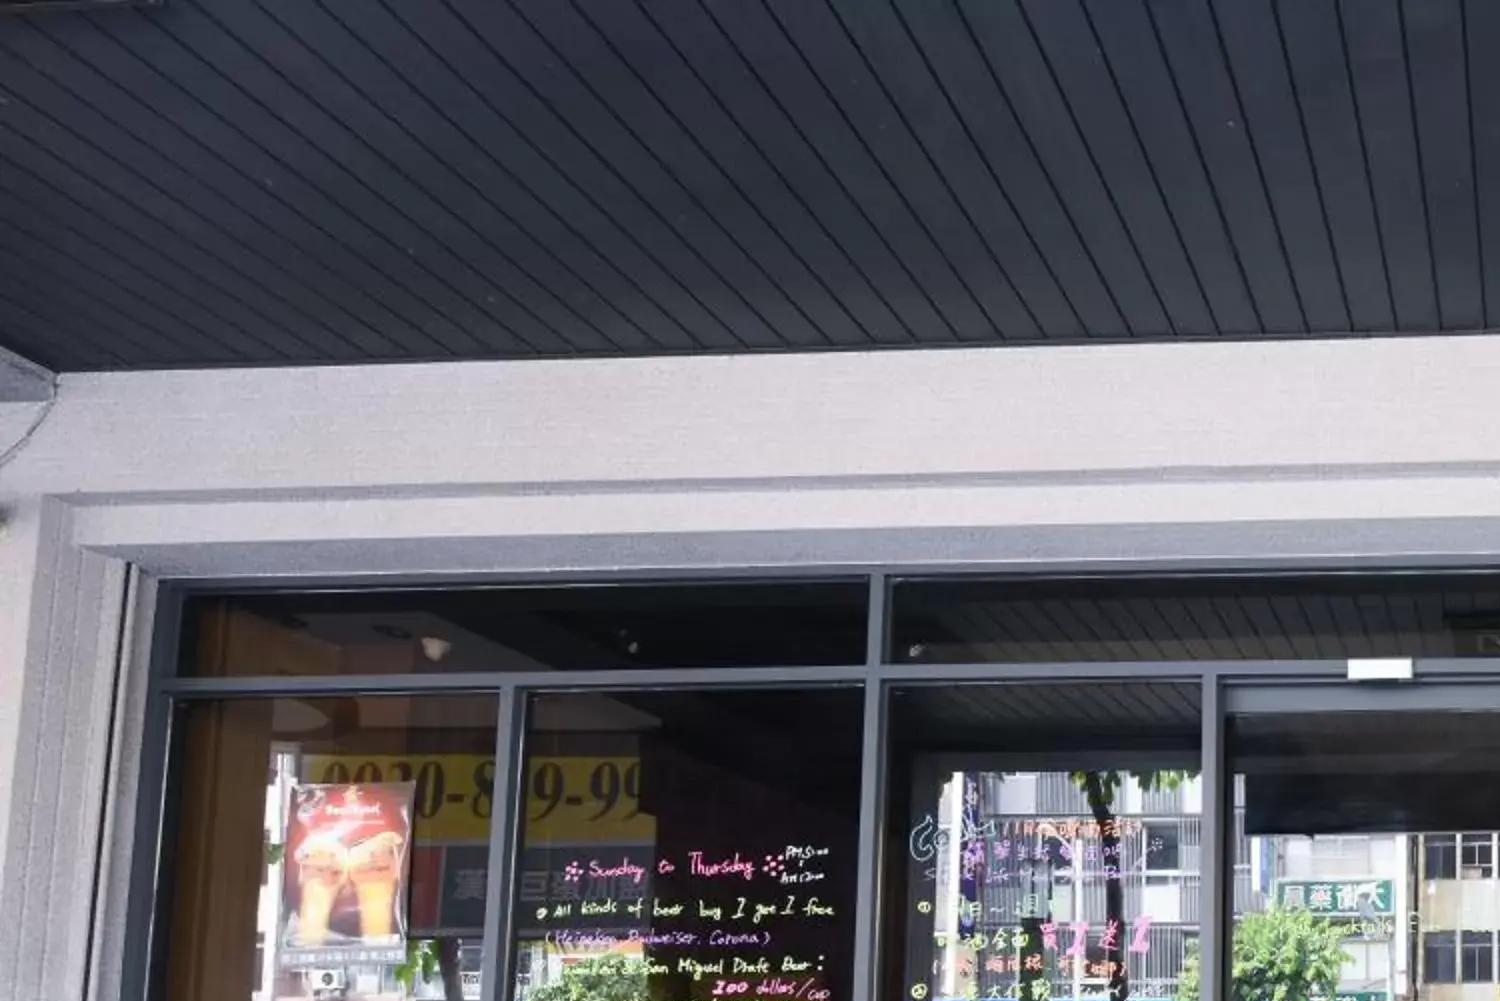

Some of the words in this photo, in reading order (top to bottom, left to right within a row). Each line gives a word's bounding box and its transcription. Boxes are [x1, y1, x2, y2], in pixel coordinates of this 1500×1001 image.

[589, 857, 645, 883] Sunday
[658, 859, 675, 874] to
[688, 851, 755, 881] Thursday
[553, 904, 572, 917] All
[627, 897, 644, 919] of
[653, 899, 684, 916] beer
[699, 899, 722, 921] buy
[802, 897, 835, 916] free
[677, 957, 724, 981] Miguel
